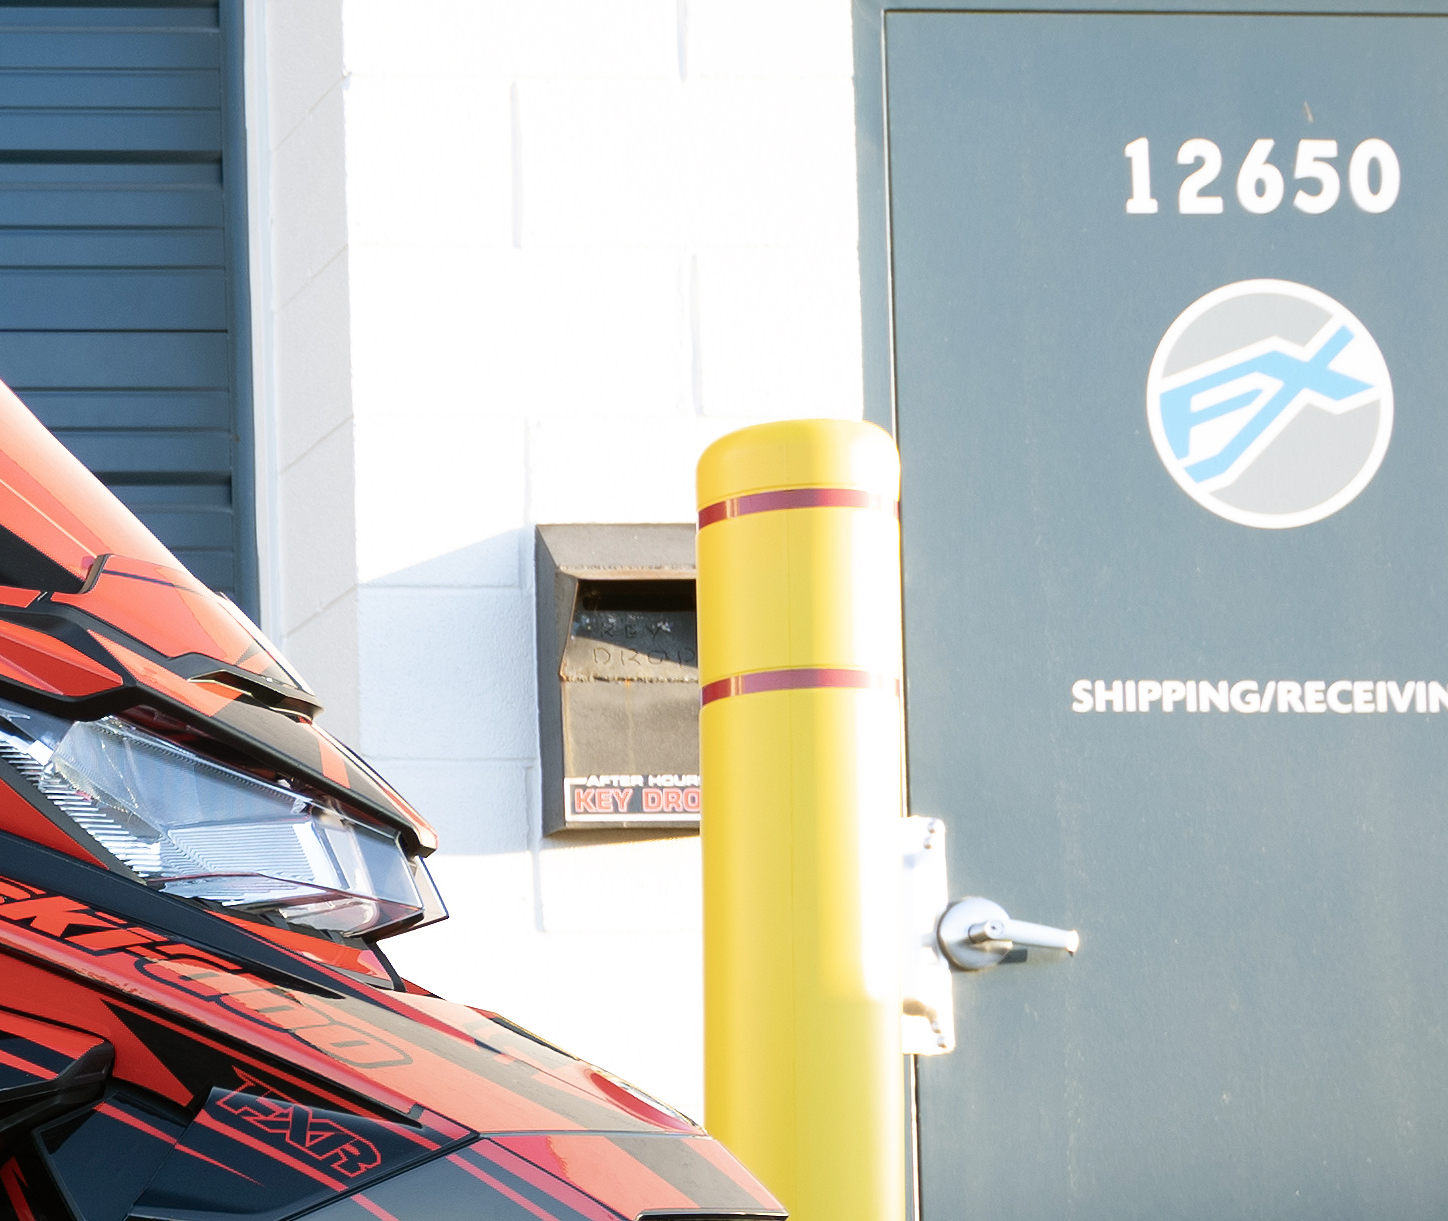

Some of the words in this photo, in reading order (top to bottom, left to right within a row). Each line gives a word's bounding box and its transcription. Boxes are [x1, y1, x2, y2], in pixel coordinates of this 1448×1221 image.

[1125, 137, 1400, 215] 12650
[574, 788, 634, 812] KEY
[642, 788, 701, 812] DRO
[586, 774, 644, 787] AFTER
[648, 774, 701, 787] HOUR
[215, 1066, 382, 1178] FXR
